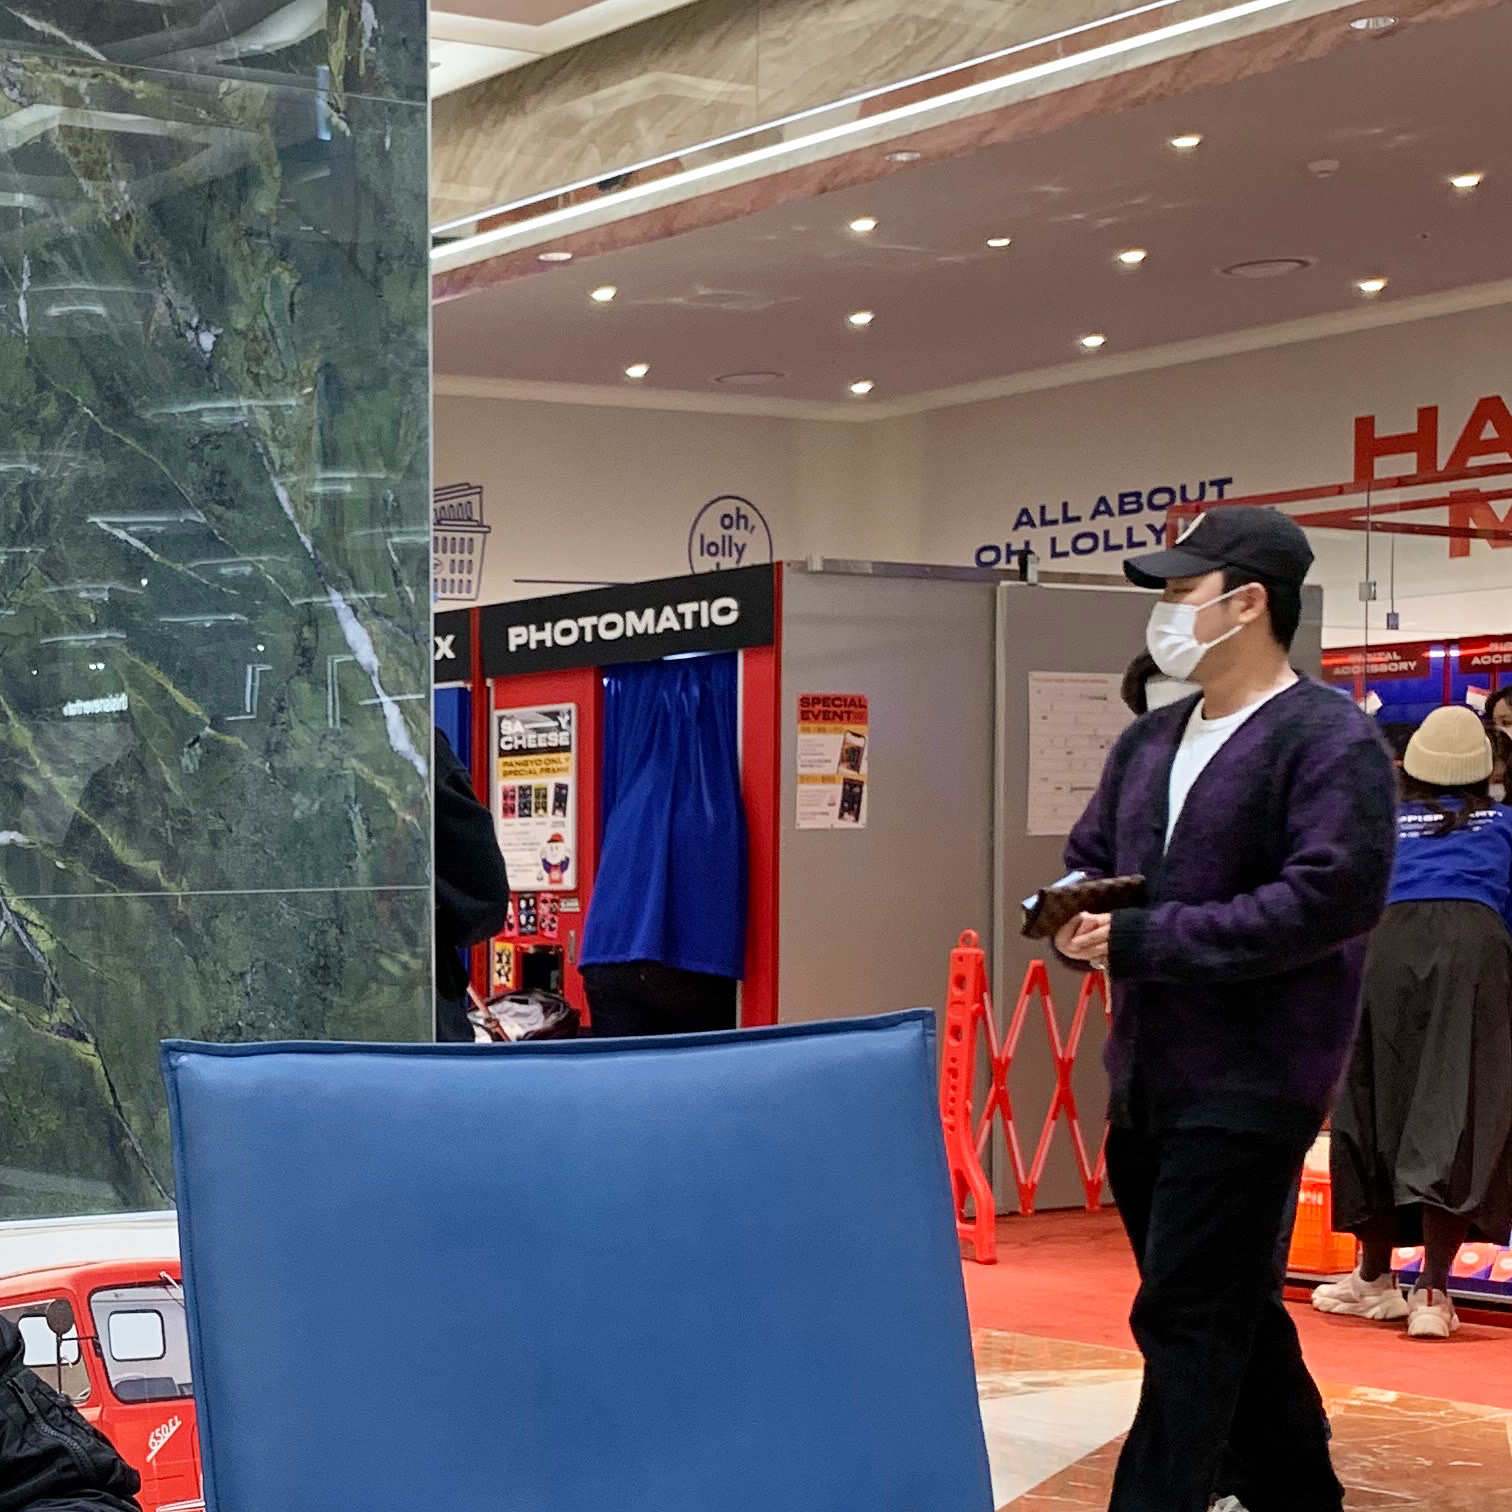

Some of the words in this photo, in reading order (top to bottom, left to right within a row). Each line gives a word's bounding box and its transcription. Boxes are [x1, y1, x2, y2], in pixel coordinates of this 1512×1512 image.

[1012, 501, 1082, 531] ALL
[1089, 477, 1233, 521] ABOUT
[720, 506, 755, 535] oh,
[700, 533, 747, 565] lolly
[974, 540, 1031, 569] OH
[1050, 522, 1167, 560] LOLLY
[507, 596, 739, 653] PHOTOMATIC
[799, 696, 867, 709] SPECIAL
[799, 710, 852, 721] EVENT
[500, 731, 570, 751] CHEESE
